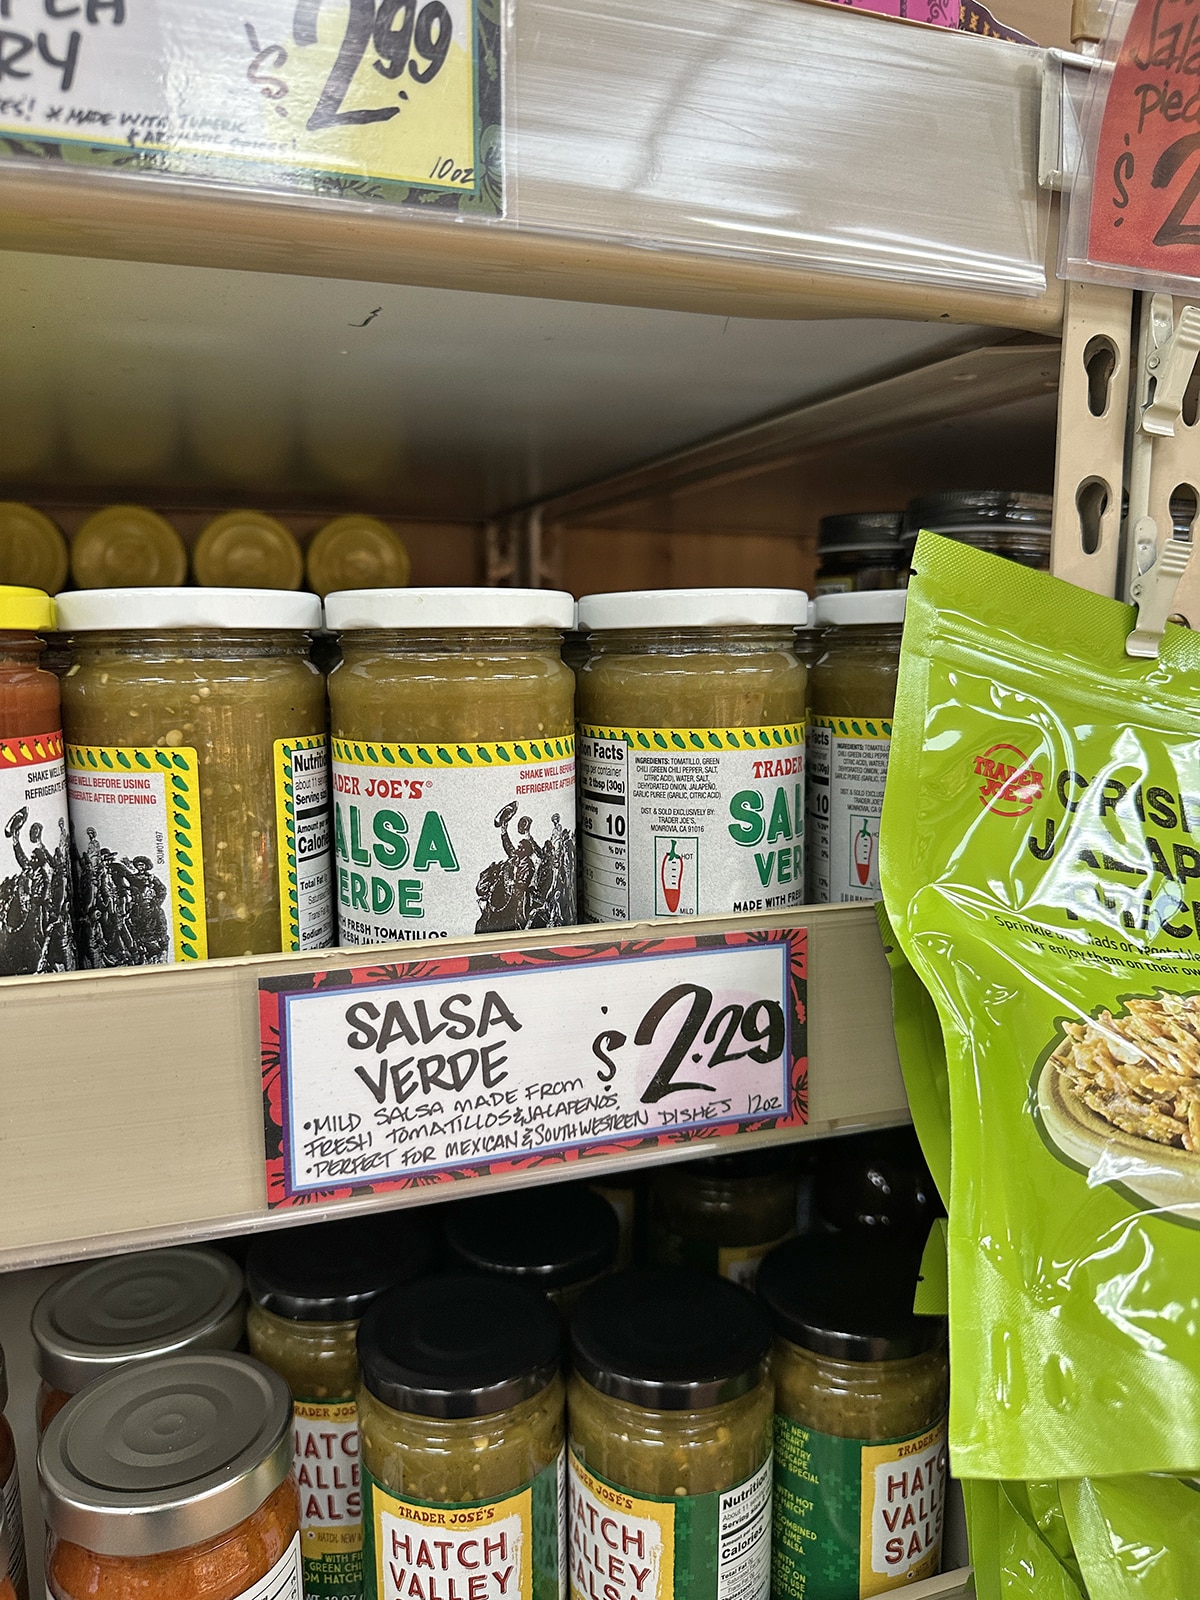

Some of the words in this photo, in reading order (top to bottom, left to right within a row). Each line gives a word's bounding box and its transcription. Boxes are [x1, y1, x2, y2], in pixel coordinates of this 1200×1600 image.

[67, 108, 116, 126] MADE
[593, 743, 624, 761] Facts
[635, 757, 670, 766] INGREDIENTS:
[27, 768, 49, 783] SHAKE
[519, 768, 543, 780] SHAKE
[544, 765, 558, 778] WELL
[973, 755, 1045, 790] TRADER
[93, 778, 121, 788] BEFORE
[123, 779, 151, 790] USING
[516, 779, 559, 795] REFRIGERATE
[606, 779, 626, 794] (30g)
[637, 782, 670, 790] DEHYDRATED
[94, 792, 116, 804] AFTER
[117, 794, 157, 805] OPENING
[633, 791, 649, 799] GARLIC
[673, 808, 706, 816] EXCLUSIVELY
[606, 813, 626, 837] 10
[658, 817, 678, 825] TRADER
[615, 862, 626, 871] 0%
[615, 877, 627, 887] 0%
[733, 898, 763, 912] MADE
[765, 895, 786, 908] WITH
[347, 918, 371, 936] FRESH
[994, 915, 1057, 939] Sprinkle
[1120, 941, 1133, 953] or
[1049, 943, 1085, 962] enjoy
[1087, 950, 1125, 968] them
[1125, 958, 1144, 970] on
[345, 990, 523, 1055] SALSA
[354, 1040, 509, 1104] VERDE
[373, 1101, 445, 1126] SALSA
[454, 1089, 519, 1113] MADE
[303, 1131, 373, 1159] FRESH
[401, 1145, 437, 1165] FOR
[445, 1130, 519, 1157] MEXICAN
[788, 1463, 820, 1484] SPECIAL
[796, 1495, 814, 1511] HOT
[398, 1506, 446, 1524] TRADER
[391, 1529, 509, 1571] HATCH
[722, 1524, 763, 1560] Calories
[325, 1553, 348, 1564] WITH
[309, 1561, 341, 1573] GREEN
[323, 1571, 362, 1585] HATCH
[389, 1564, 516, 1600] VALLEY
[792, 1571, 806, 1584] ON
